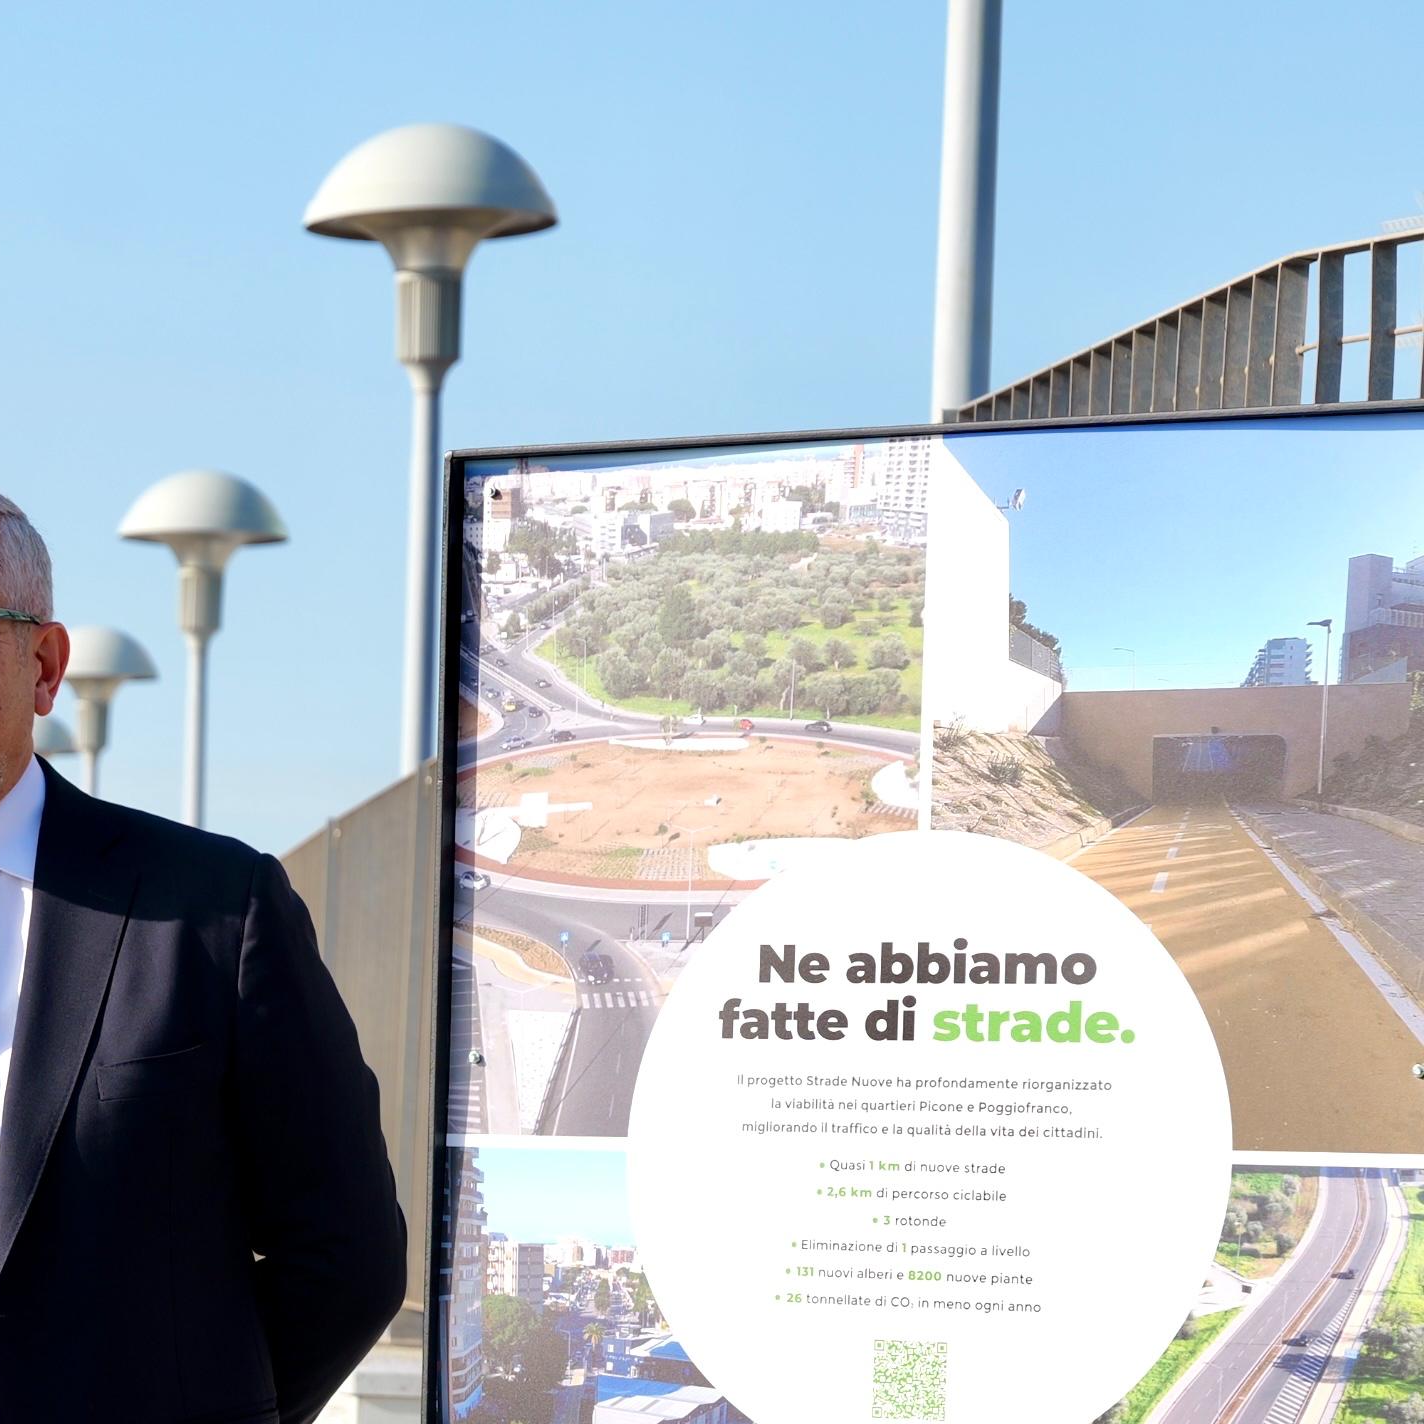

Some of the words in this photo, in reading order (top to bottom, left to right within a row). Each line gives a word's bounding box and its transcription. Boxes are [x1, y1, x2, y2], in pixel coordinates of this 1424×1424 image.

[758, 944, 831, 984] Ne
[845, 937, 1097, 986] abbiamo
[718, 997, 849, 1041] fatte
[864, 994, 917, 1042] di
[932, 1000, 1136, 1045] strade.
[737, 1073, 744, 1085] Il
[747, 1075, 803, 1089] progetto
[806, 1075, 848, 1087] Strade
[851, 1076, 893, 1088] Nuove
[896, 1076, 912, 1088] ha
[915, 1076, 1019, 1091] profondamente
[1022, 1078, 1112, 1093] riorganizzato
[771, 1097, 782, 1109] la
[785, 1098, 835, 1110] viabilità
[838, 1099, 857, 1111] nei
[860, 1099, 916, 1113] quartieri
[919, 1100, 964, 1113] Picone
[966, 1103, 975, 1113] e
[978, 1101, 1073, 1116] Poggiofranco,
[741, 1120, 818, 1135] migliorando
[821, 1121, 828, 1133] il
[831, 1122, 878, 1135] traffico
[881, 1126, 889, 1135] e
[892, 1123, 903, 1135] la
[906, 1123, 951, 1138] qualità
[955, 1124, 987, 1137] della
[990, 1125, 1015, 1137] vita
[1018, 1125, 1039, 1138] dei
[1042, 1126, 1103, 1139] cittadini.
[829, 1159, 866, 1172] Quasi
[868, 1160, 874, 1171] 1
[878, 1160, 900, 1172] km
[904, 1160, 916, 1172] di
[920, 1163, 960, 1173] nuove
[964, 1163, 1006, 1175] strade
[827, 1186, 847, 1199] 2,6
[850, 1186, 873, 1198] km
[876, 1187, 888, 1199] di
[892, 1190, 949, 1201] percorso
[952, 1189, 1007, 1202] ciclabile
[883, 1215, 891, 1226] 3
[895, 1215, 947, 1228] rotonde
[801, 1239, 882, 1253] Eliminazione
[885, 1241, 898, 1253] di
[901, 1242, 907, 1253] 1
[910, 1245, 977, 1258] passaggio
[980, 1247, 988, 1256] a
[991, 1244, 1031, 1258] livello
[796, 1266, 815, 1277] 131
[818, 1267, 853, 1279] nuovi
[856, 1267, 893, 1280] alberi
[896, 1271, 905, 1281] e
[907, 1270, 942, 1282] 8200
[946, 1273, 987, 1284] nuove
[990, 1272, 1033, 1286] piante
[786, 1292, 803, 1304] 26
[806, 1293, 871, 1307] tonnellate
[874, 1295, 887, 1307] di
[918, 1296, 930, 1309] in
[933, 1300, 971, 1310] meno
[974, 1299, 1004, 1314] ogni
[1007, 1303, 1042, 1313] anno
